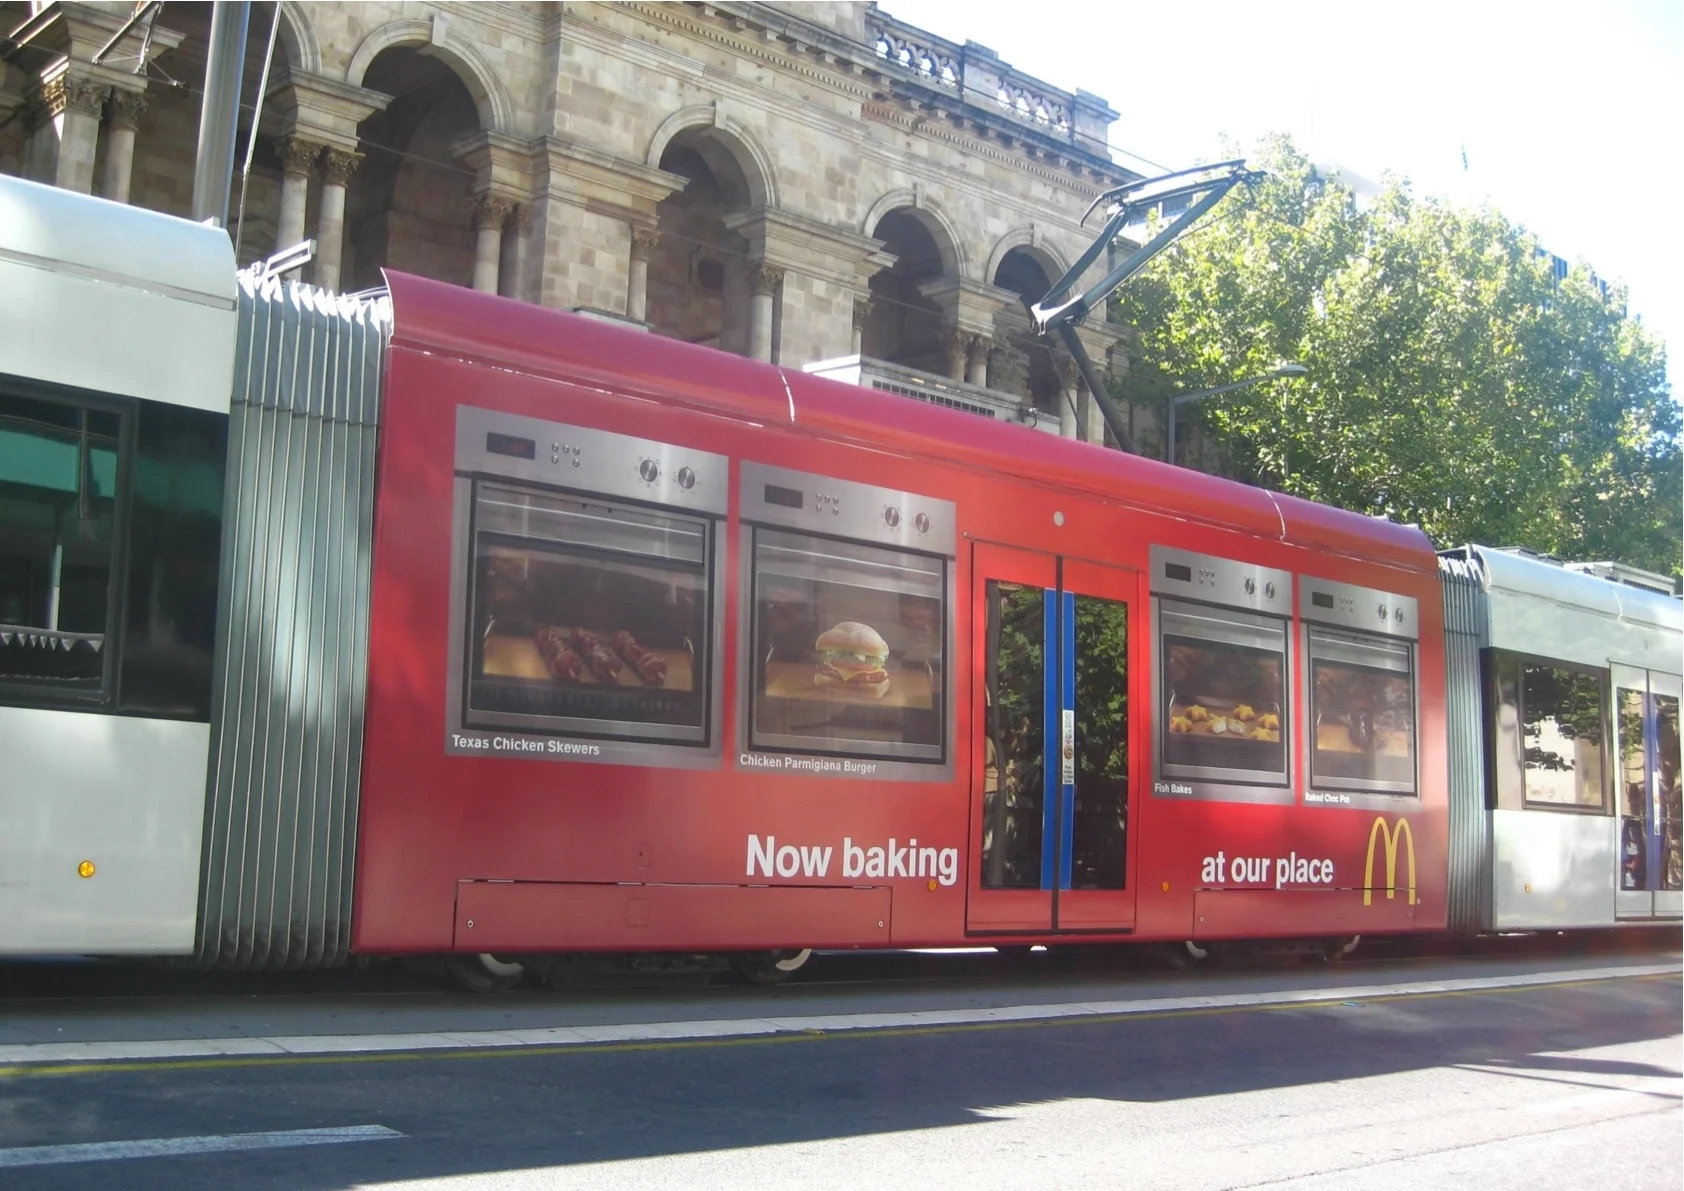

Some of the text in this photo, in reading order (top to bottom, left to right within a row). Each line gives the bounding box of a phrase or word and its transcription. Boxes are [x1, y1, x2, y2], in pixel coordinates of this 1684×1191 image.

[452, 734, 600, 755] Texas Chicken Skewers
[740, 754, 877, 774] Chicken Parmigiana Burger
[1154, 783, 1193, 794] Fish Bakes
[746, 834, 958, 886] Now baking
[1201, 851, 1334, 889] at our place
